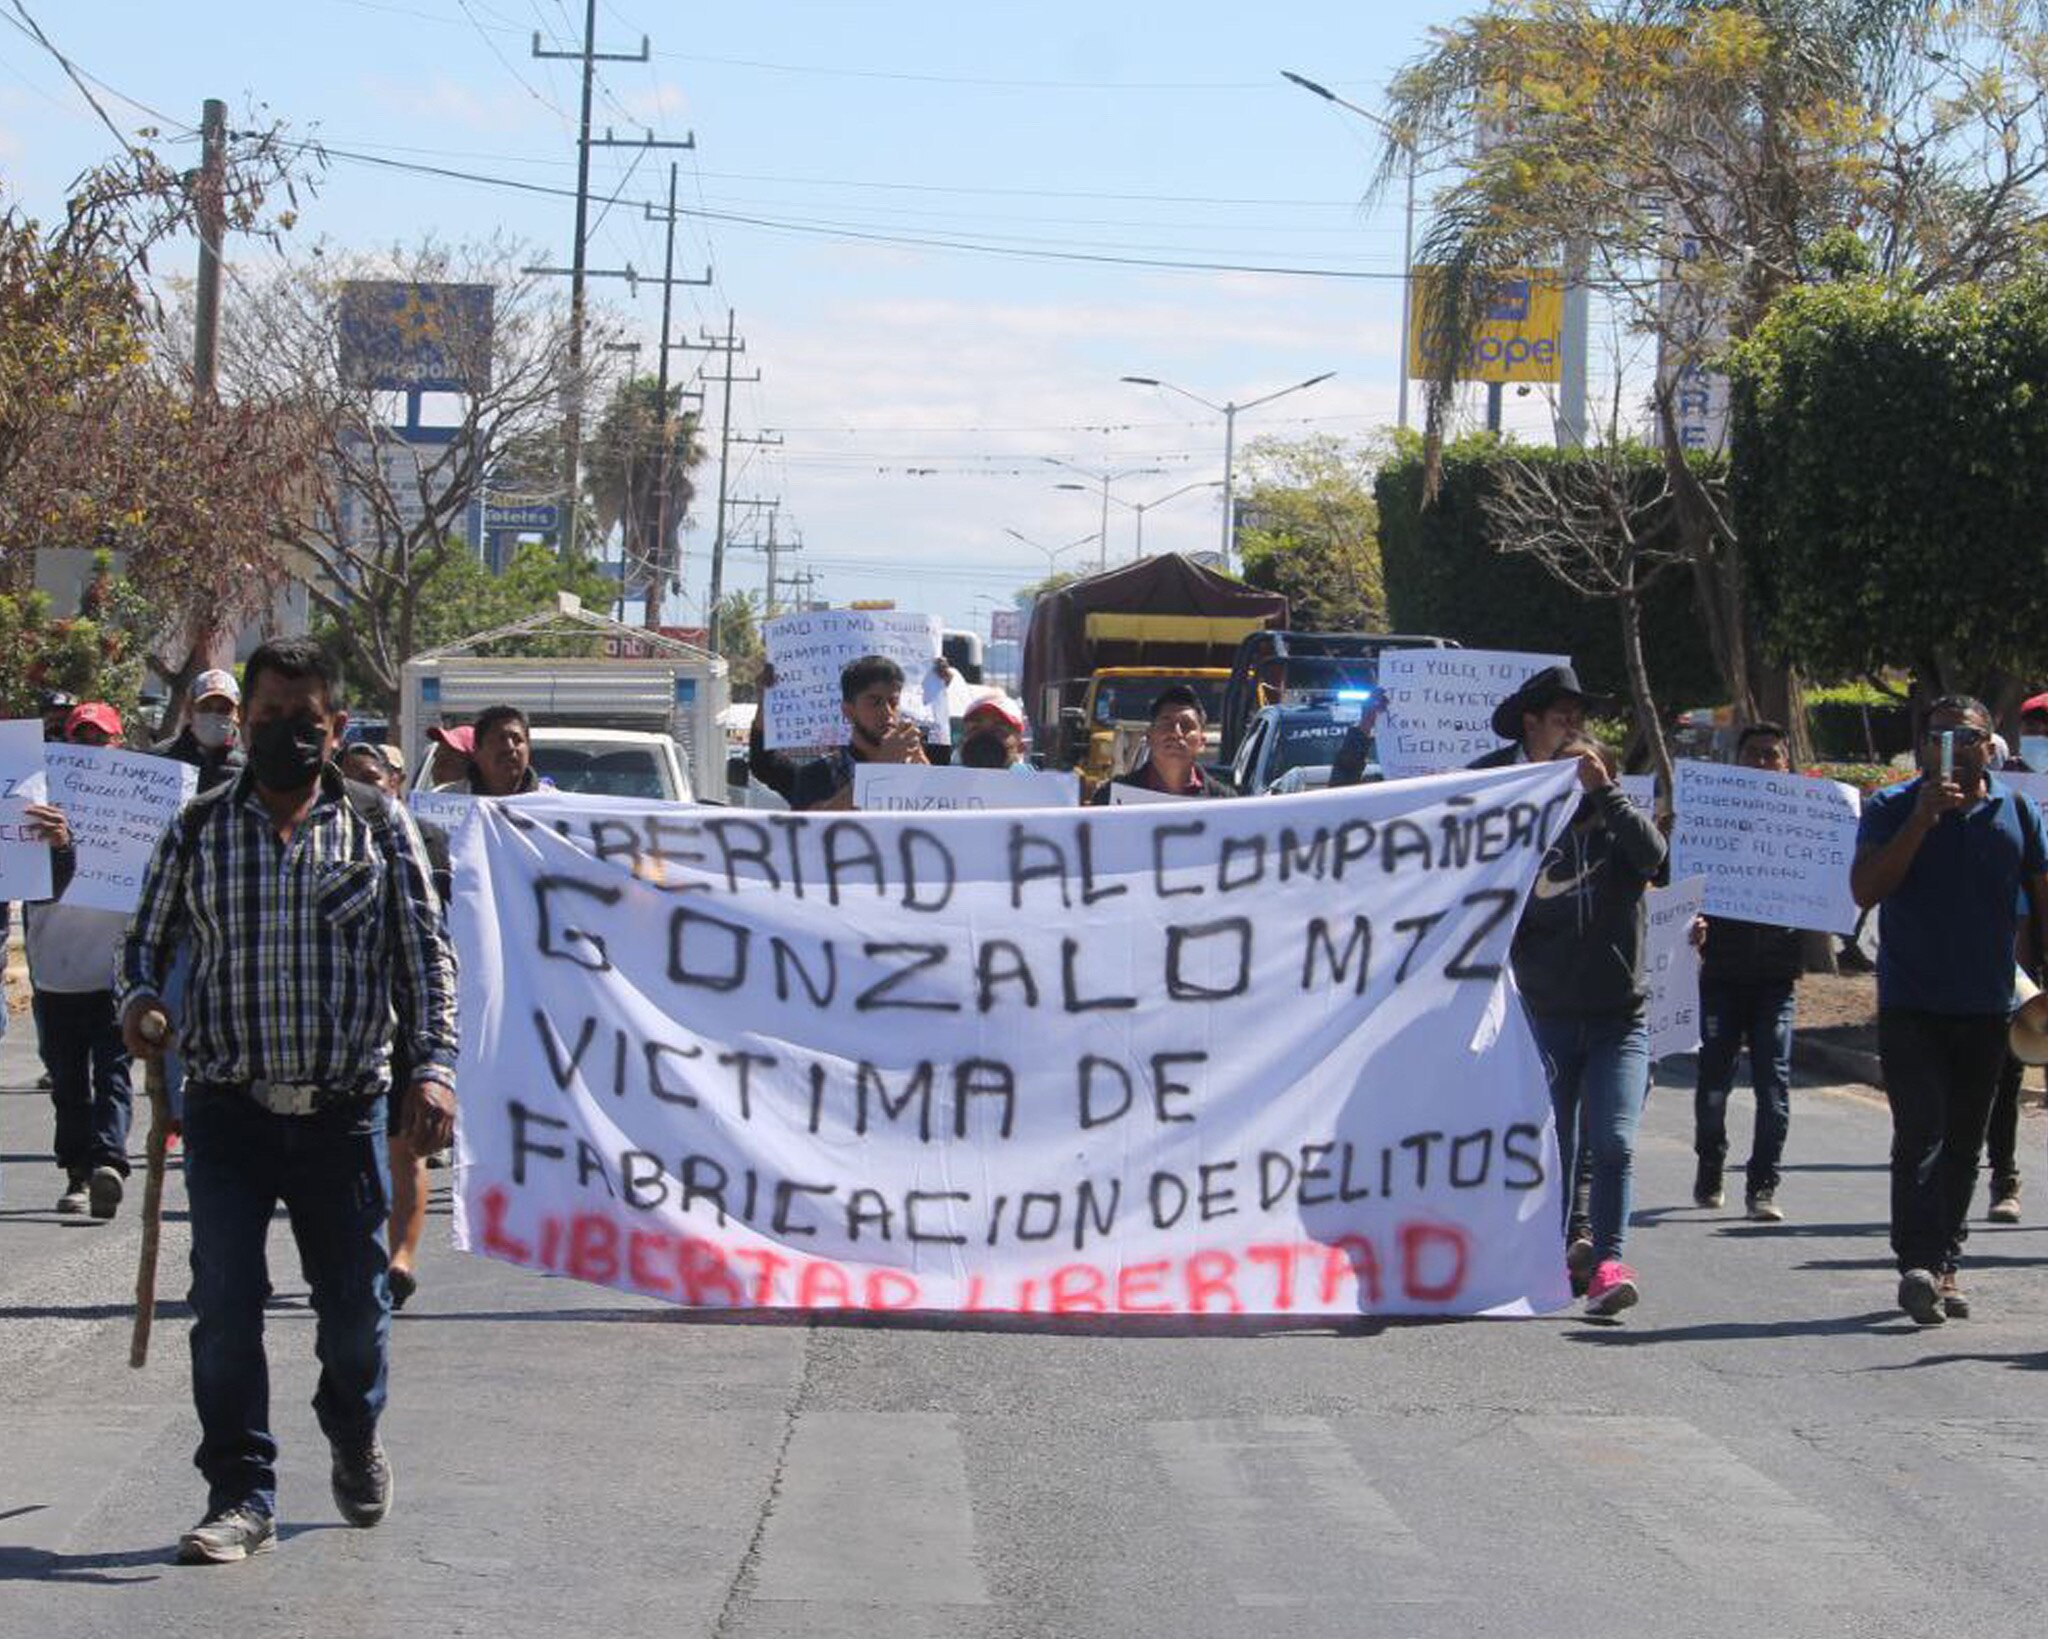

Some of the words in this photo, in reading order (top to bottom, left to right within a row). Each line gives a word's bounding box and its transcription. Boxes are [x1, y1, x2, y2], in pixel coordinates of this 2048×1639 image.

[1009, 820, 1127, 909] AL
[533, 873, 1254, 1014] GONZALO
[1301, 888, 1519, 996] MTZ
[531, 1008, 1015, 1145] VICTIMA
[1077, 1051, 1209, 1131] DE
[507, 1100, 1121, 1252] FABRICACION
[1149, 1160, 1239, 1232] DE
[1259, 1122, 1546, 1212] DELITOS
[968, 1217, 1472, 1315] LIBERTAD
